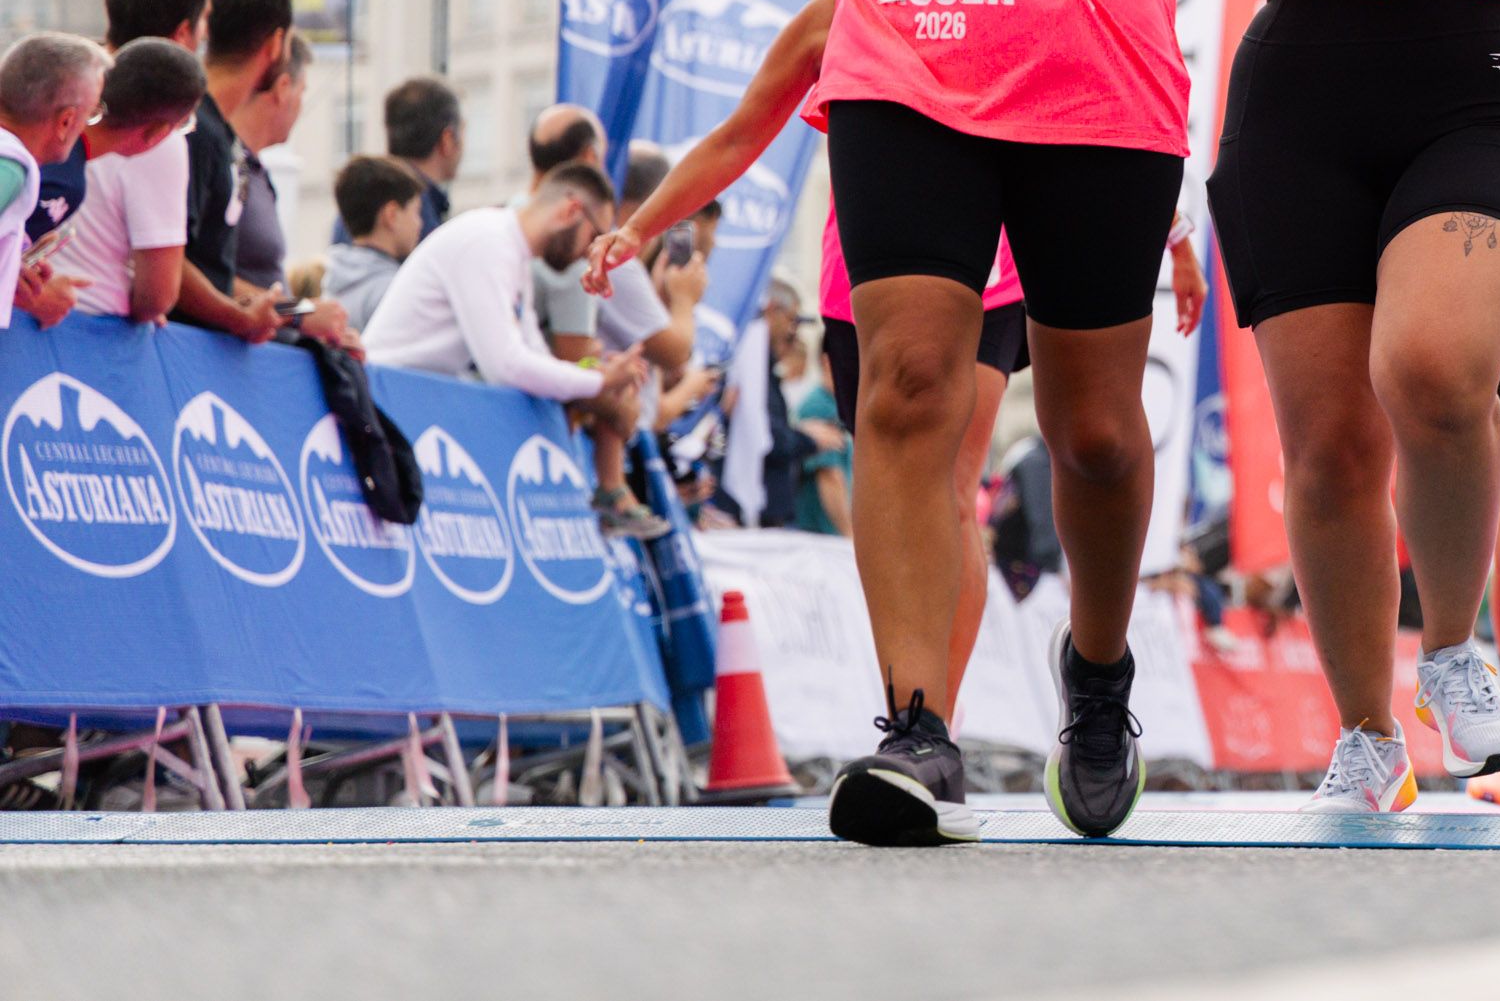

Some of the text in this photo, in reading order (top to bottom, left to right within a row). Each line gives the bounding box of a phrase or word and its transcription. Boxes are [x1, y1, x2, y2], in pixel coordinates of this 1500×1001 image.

[914, 11, 966, 40] 2026
[19, 443, 169, 525] ASTURIANA
[184, 453, 300, 541] ASTURIANA
